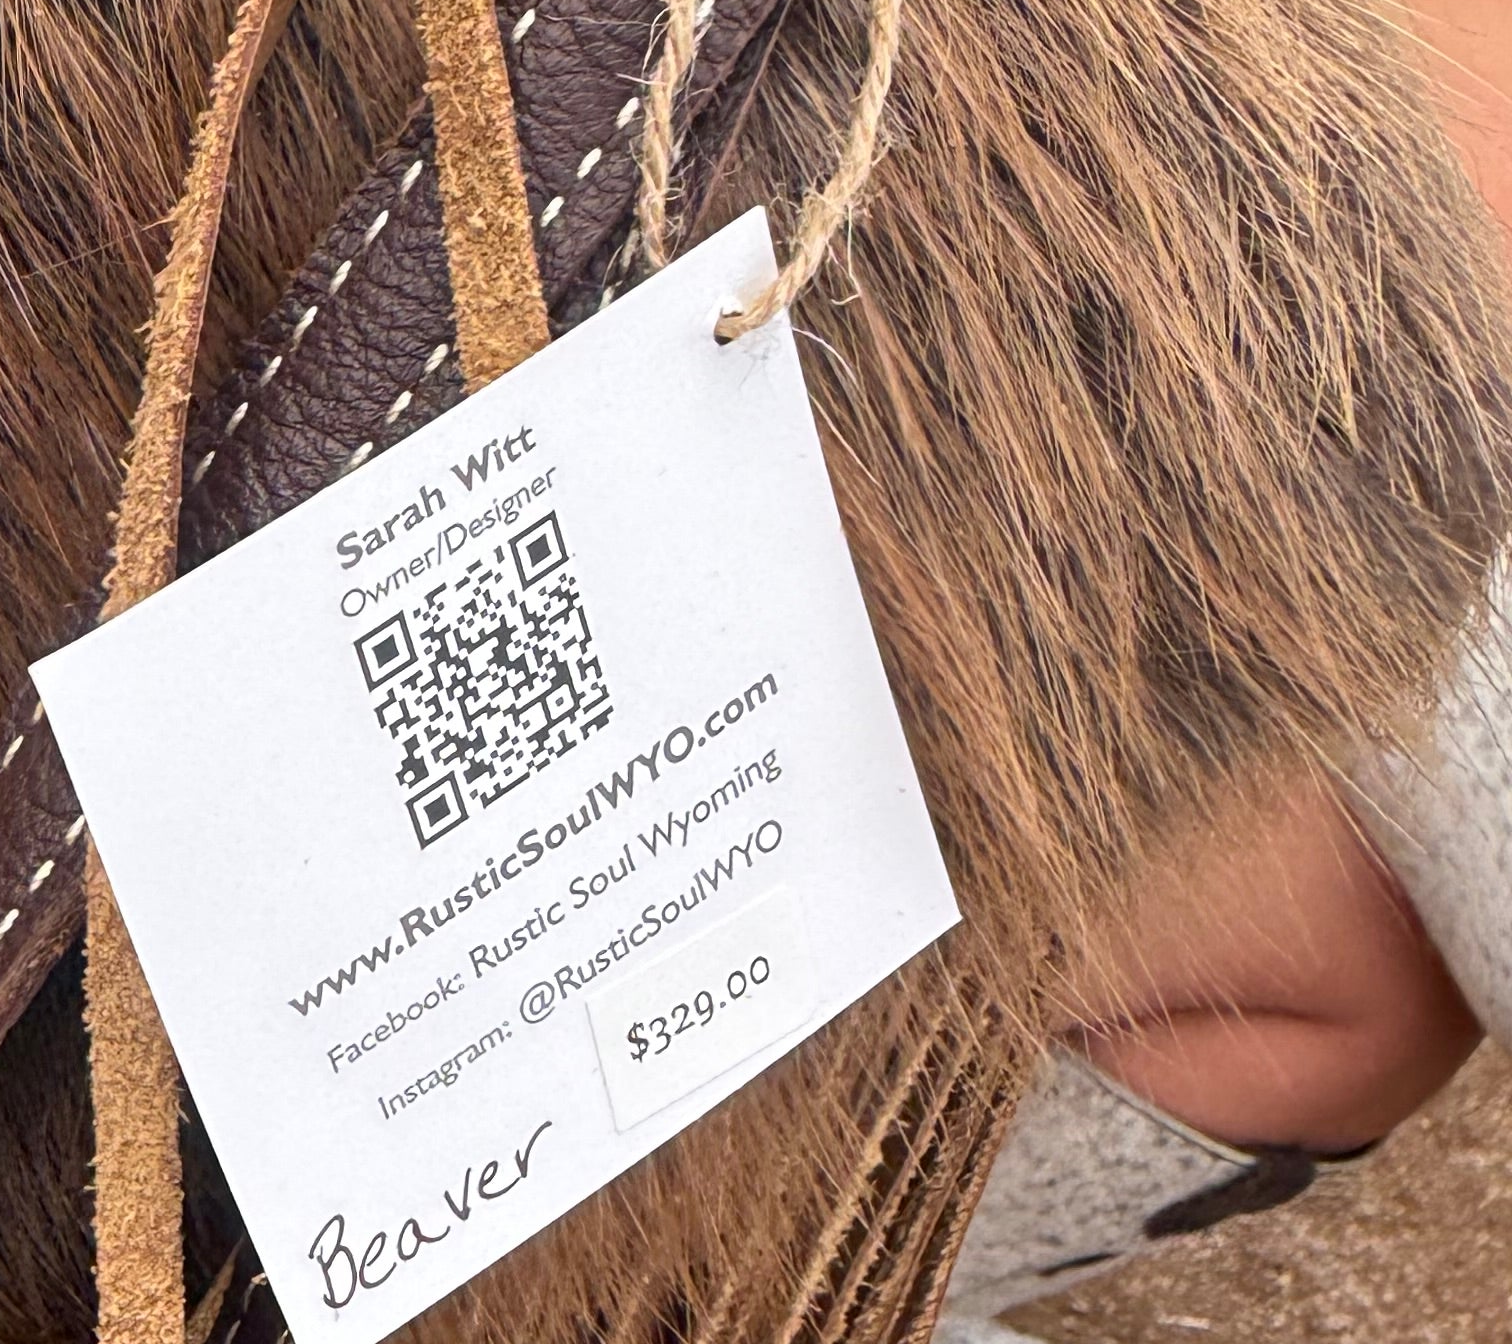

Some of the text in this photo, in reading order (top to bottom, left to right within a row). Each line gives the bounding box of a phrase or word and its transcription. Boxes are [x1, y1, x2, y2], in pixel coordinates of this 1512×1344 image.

[336, 426, 538, 570] Sarah Witt
[340, 467, 556, 617] Owner/Designer
[289, 673, 778, 1016] www.RusticSoulWYO.com
[326, 748, 784, 1074] Facebook: Rustic Soul Wyoming
[377, 820, 782, 1120] Instagram: @RusticSoulWYO
[627, 955, 770, 1062] $329.00
[308, 1121, 553, 1309] Beaver
